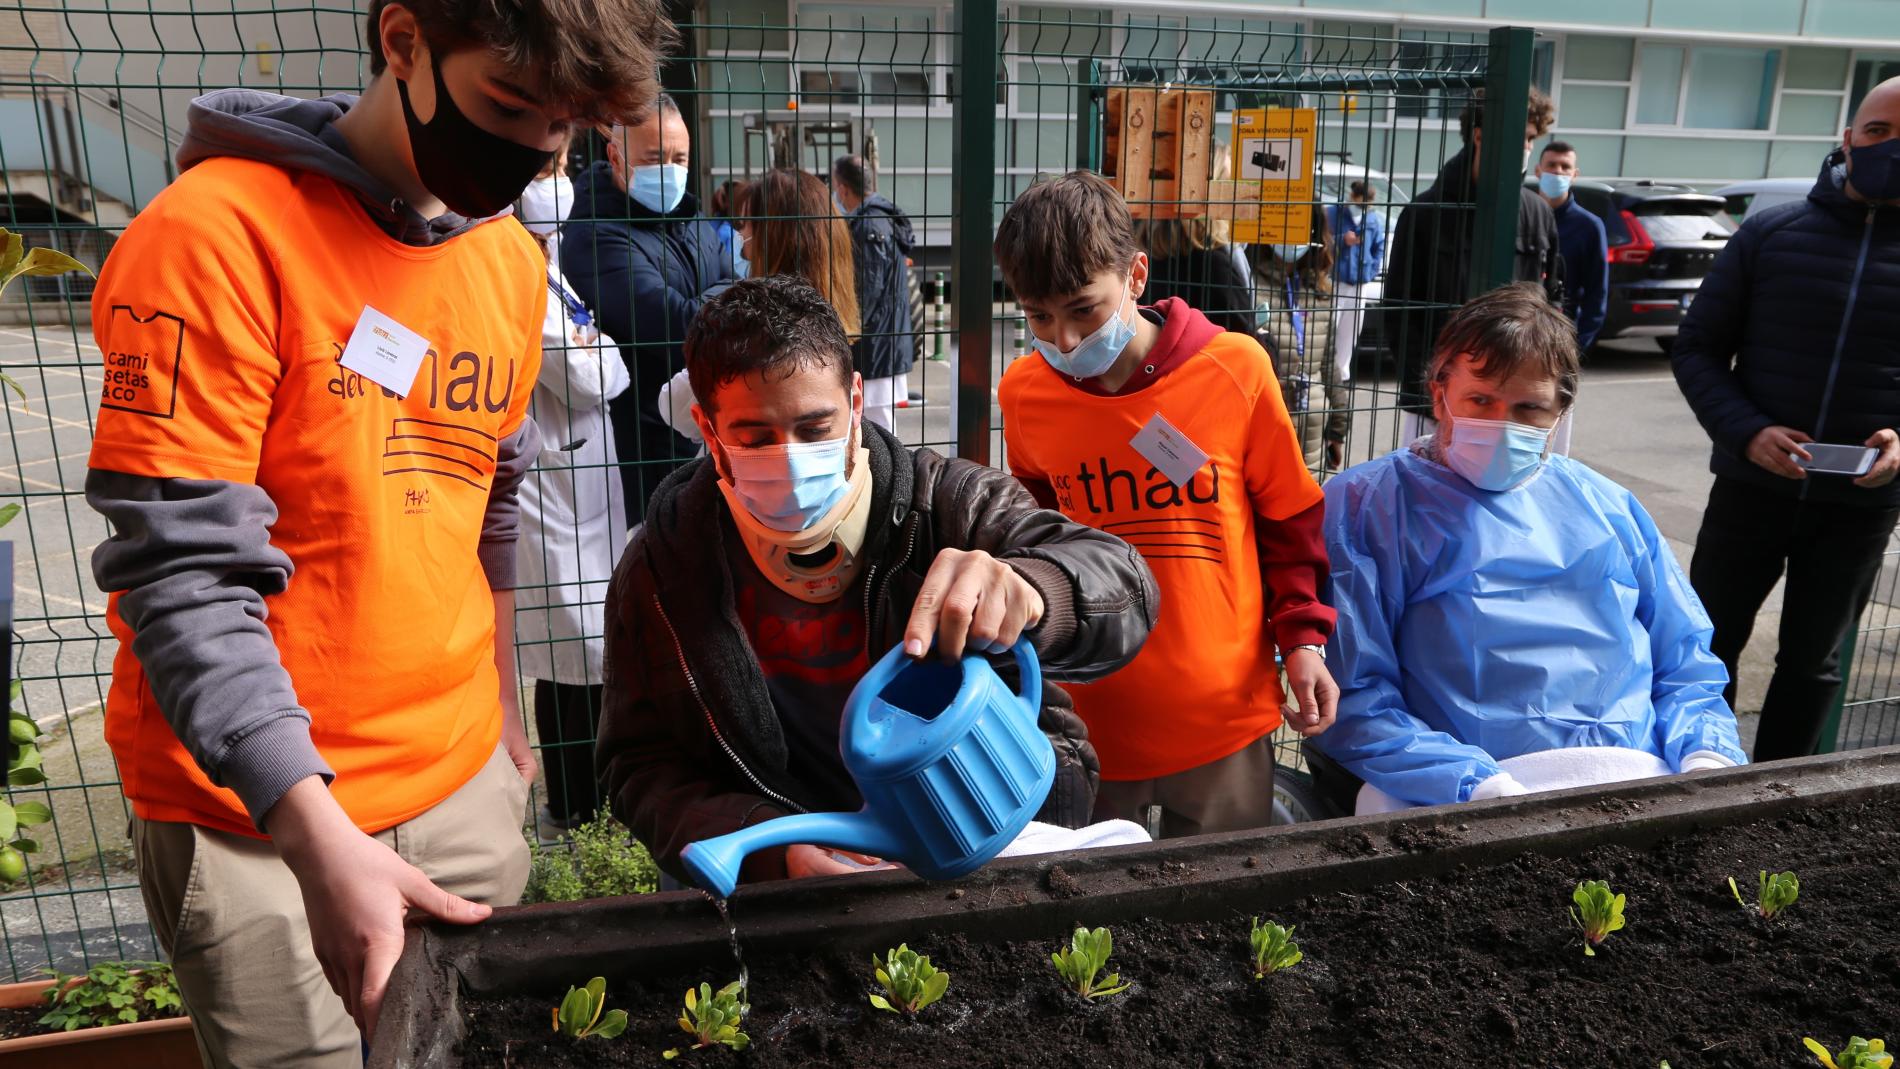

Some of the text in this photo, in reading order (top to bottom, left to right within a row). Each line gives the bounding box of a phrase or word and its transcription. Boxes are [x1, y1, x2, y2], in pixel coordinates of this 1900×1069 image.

[108, 351, 149, 370] cami
[104, 369, 149, 389] setas
[1076, 456, 1219, 514] thau
